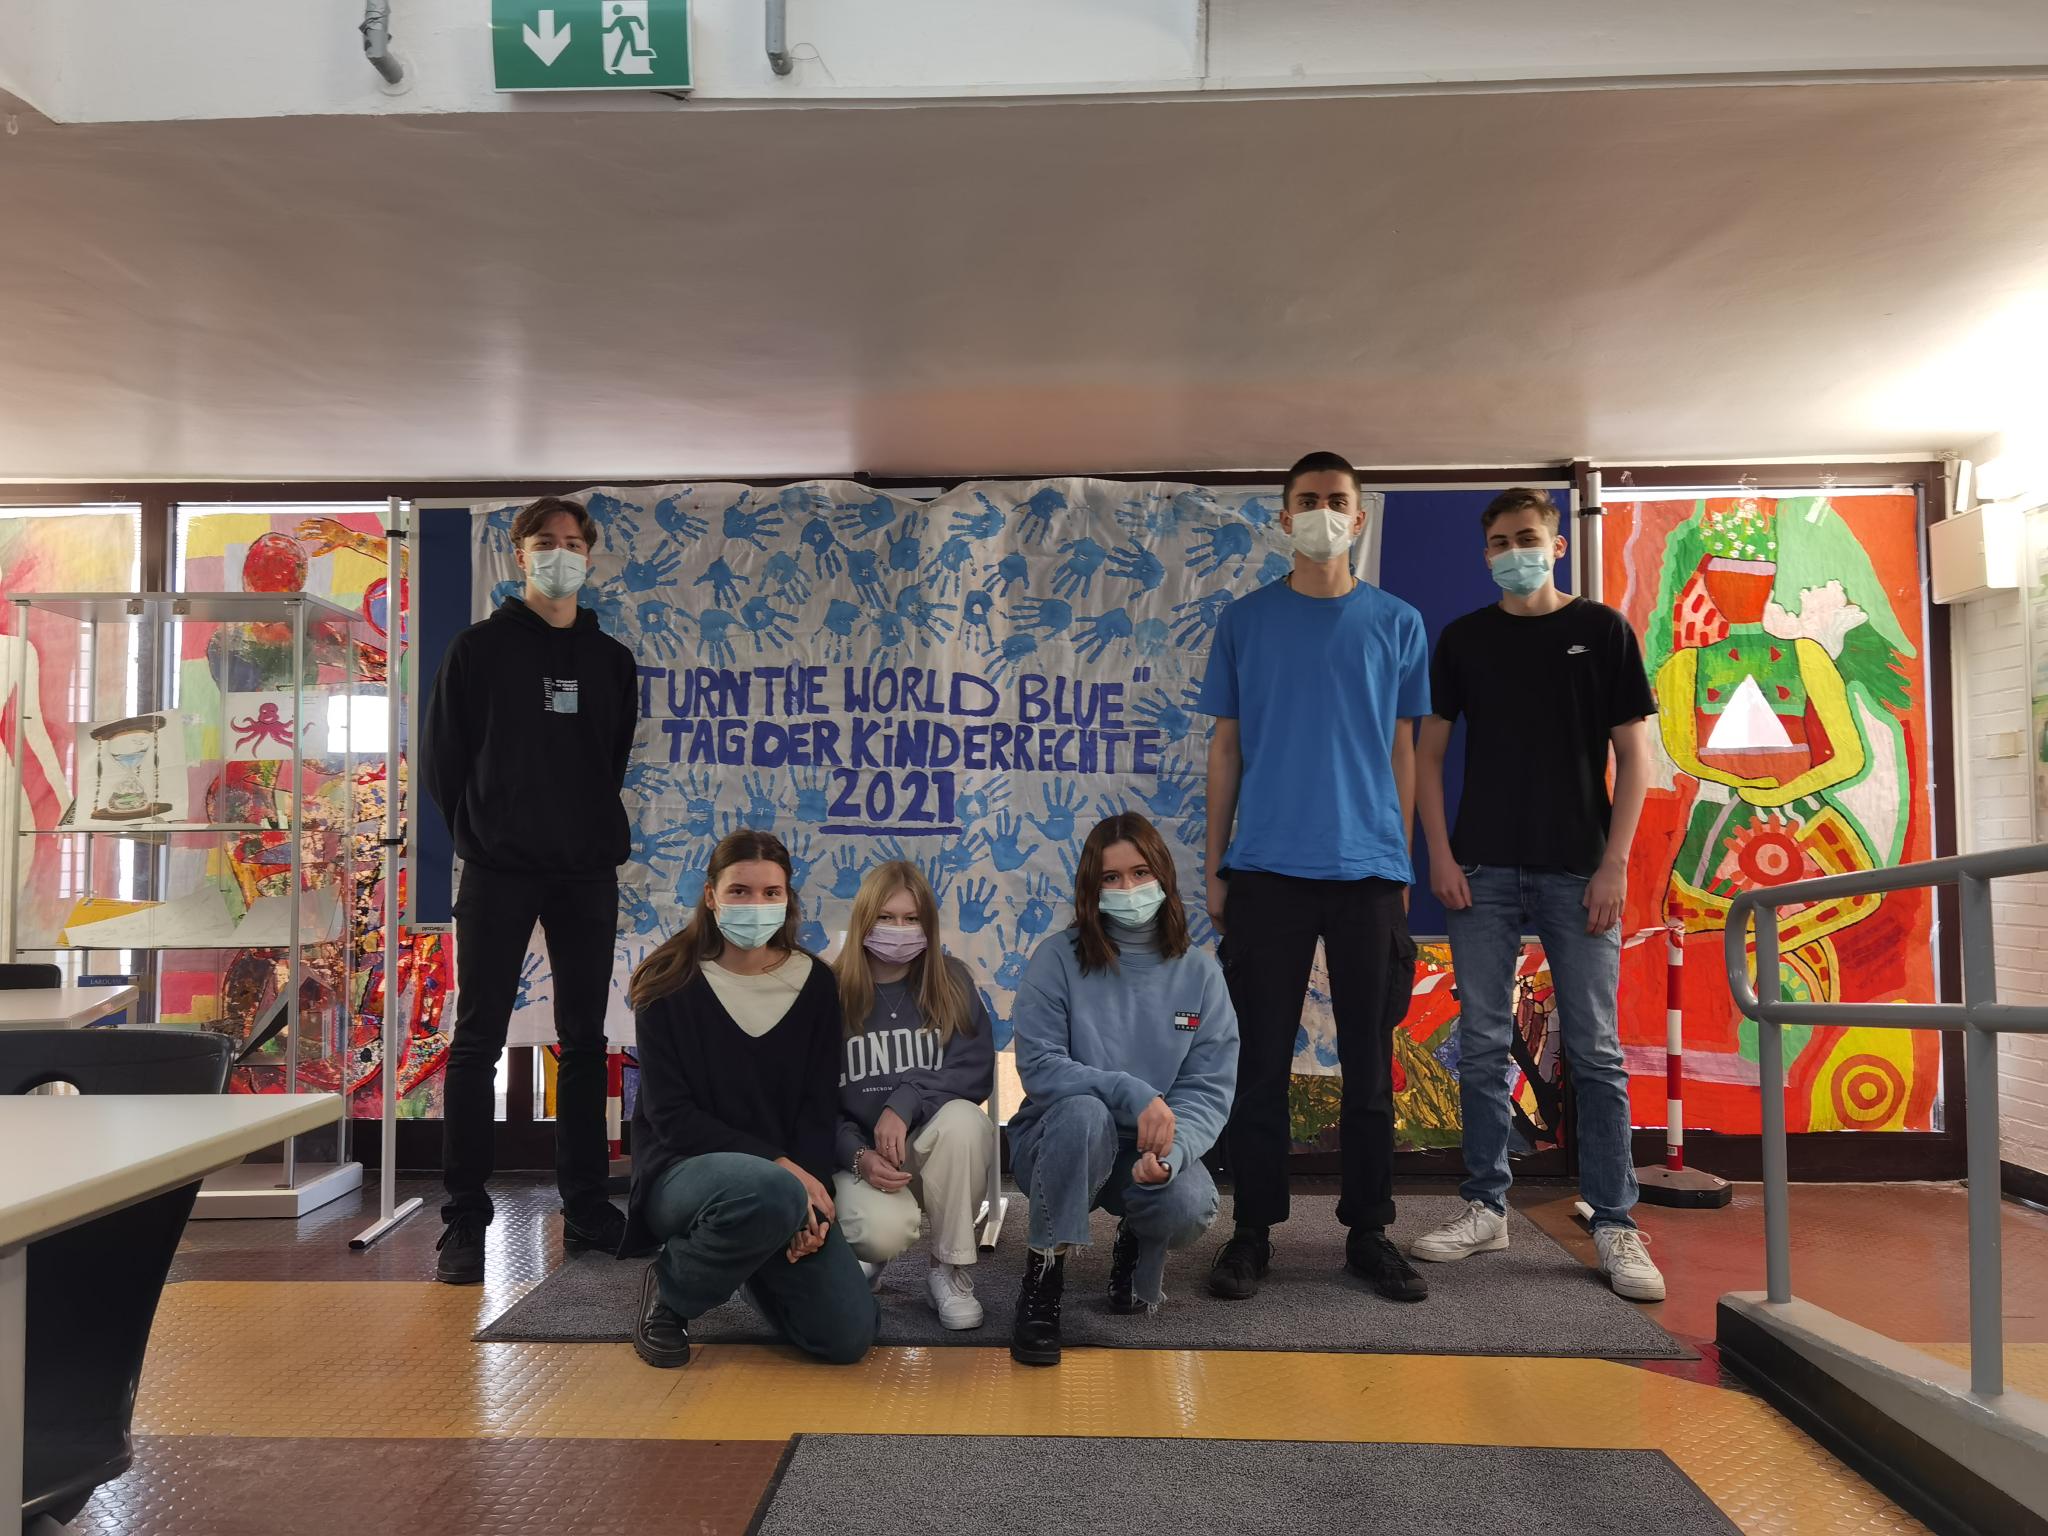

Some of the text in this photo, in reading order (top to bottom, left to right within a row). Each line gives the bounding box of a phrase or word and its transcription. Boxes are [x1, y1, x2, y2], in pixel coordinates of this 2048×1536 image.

[844, 666, 1000, 717] WORLD
[662, 719, 748, 766] TAG
[752, 720, 843, 768] DER
[828, 768, 955, 823] 2021
